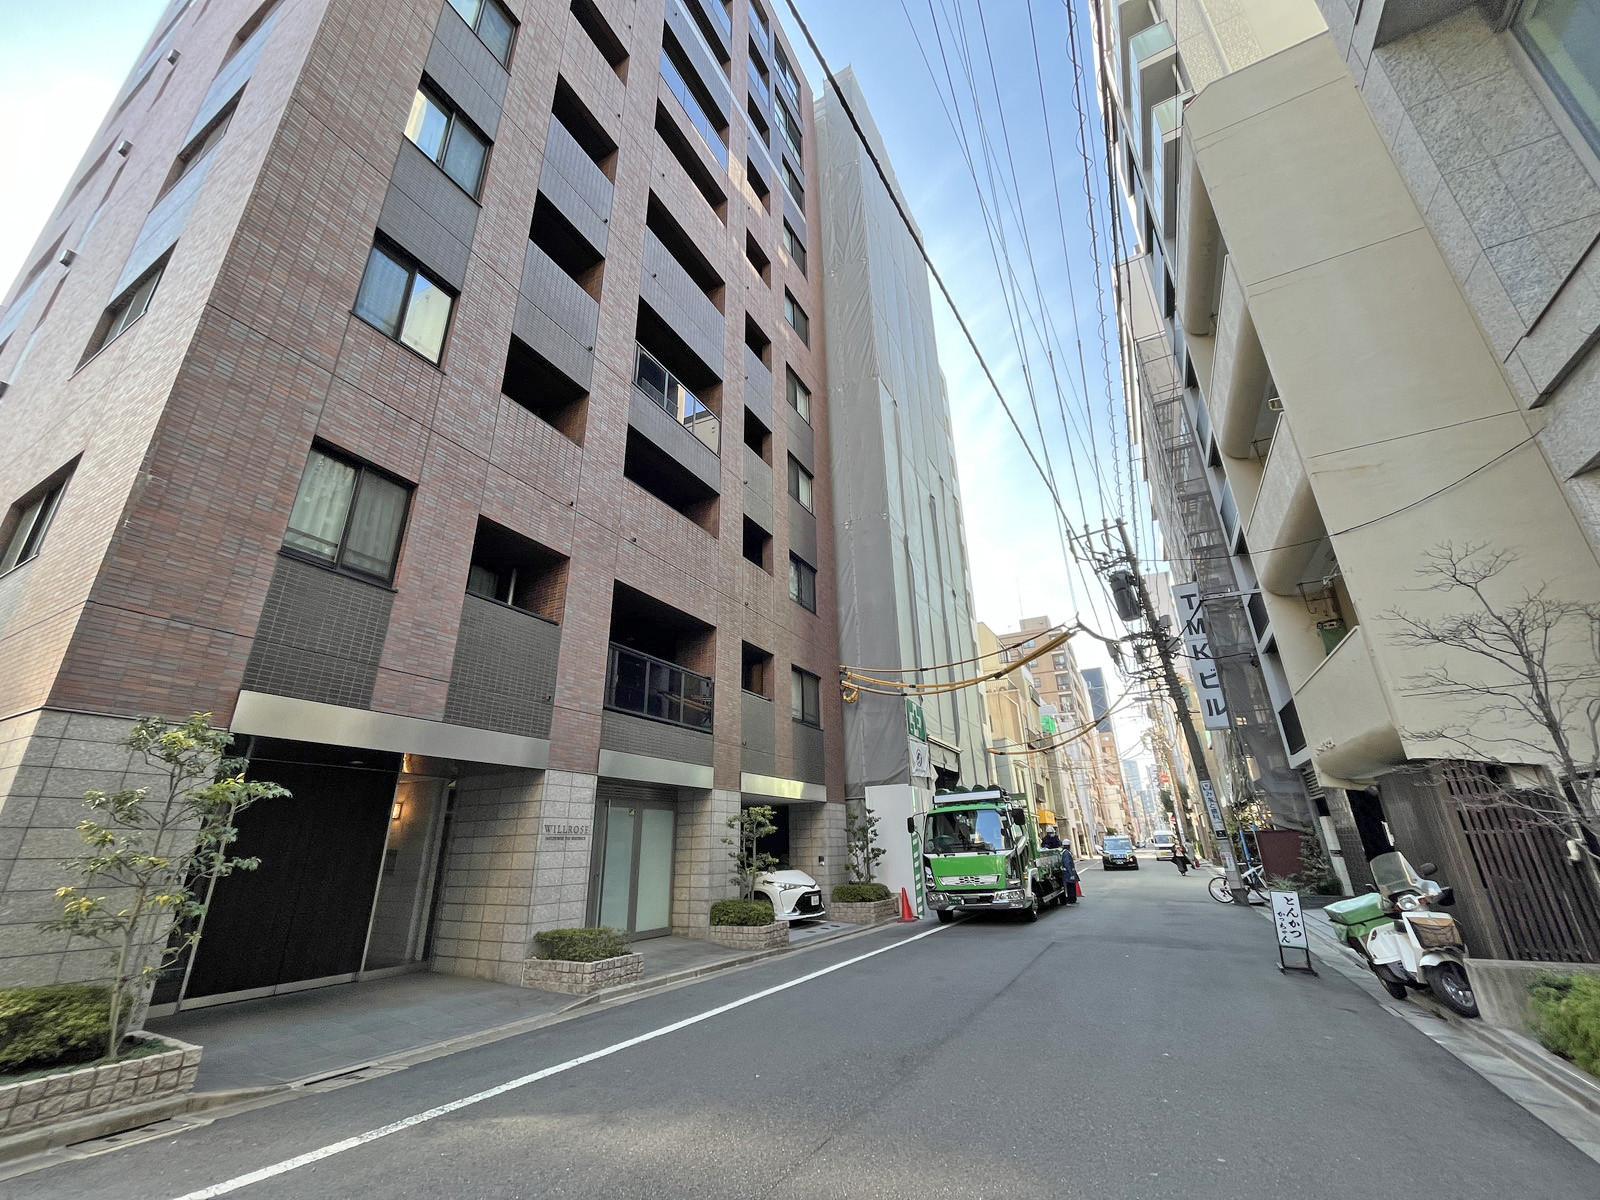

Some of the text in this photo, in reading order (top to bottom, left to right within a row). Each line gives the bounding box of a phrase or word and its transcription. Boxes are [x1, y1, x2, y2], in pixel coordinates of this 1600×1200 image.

[1180, 593, 1226, 717] TMKビル
[544, 824, 589, 834] WILLROSE
[1277, 911, 1291, 943] かっちゃん
[1284, 896, 1302, 938] とんかつ
